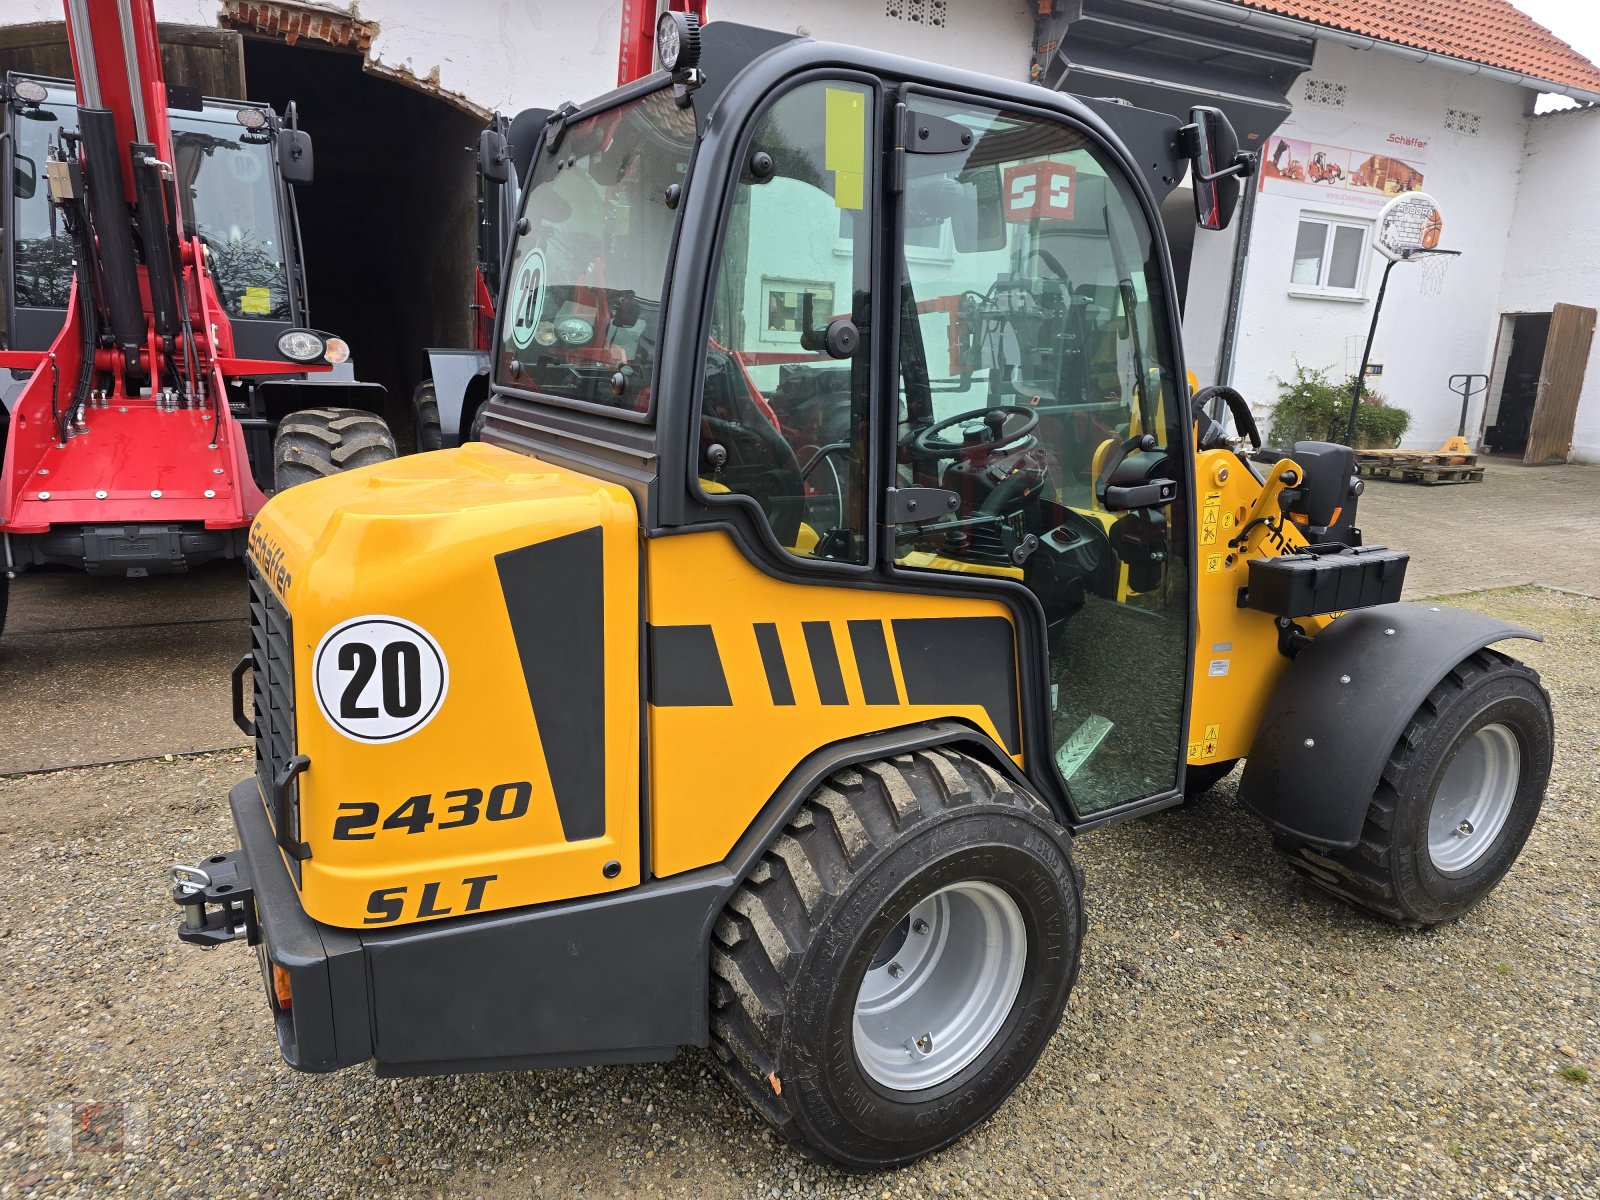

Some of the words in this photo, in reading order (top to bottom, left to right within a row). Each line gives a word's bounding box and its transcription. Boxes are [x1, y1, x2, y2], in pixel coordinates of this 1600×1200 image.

[1386, 133, 1428, 149] Schäffer
[1397, 205, 1434, 217] HUDORA
[515, 268, 541, 329] 20
[248, 521, 292, 598] Schäffer
[337, 640, 422, 719] 20
[332, 780, 534, 841] 2430
[362, 874, 499, 925] SLT
